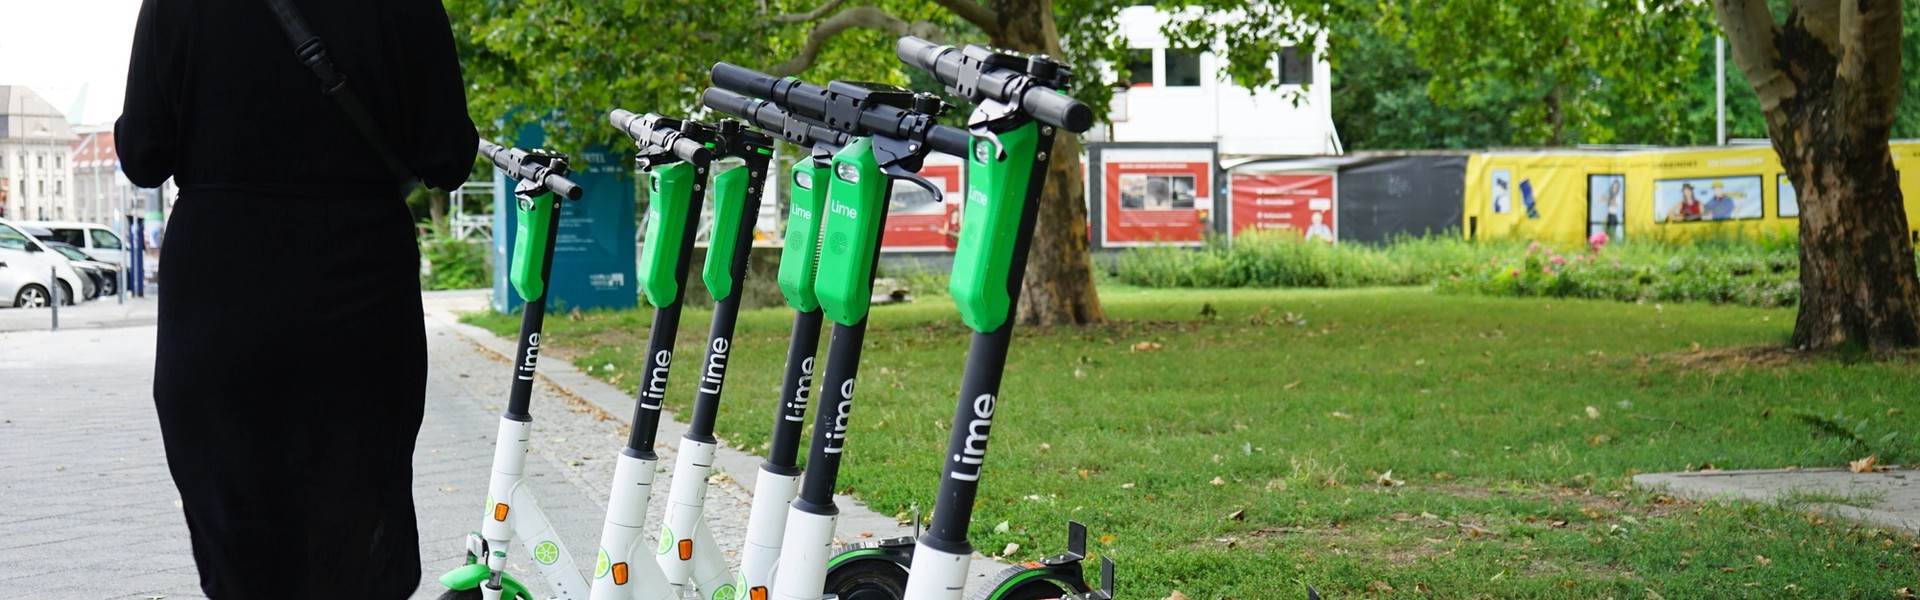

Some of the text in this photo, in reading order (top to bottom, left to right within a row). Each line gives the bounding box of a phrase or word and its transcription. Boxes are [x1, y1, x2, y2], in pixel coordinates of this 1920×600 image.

[791, 203, 812, 220] Lime
[831, 199, 858, 219] Lime
[518, 332, 542, 381] Lime
[641, 349, 671, 410] Lime
[700, 337, 729, 396] Lime
[785, 356, 815, 422] Lime
[824, 378, 855, 455] Lime
[950, 393, 996, 482] Lime
